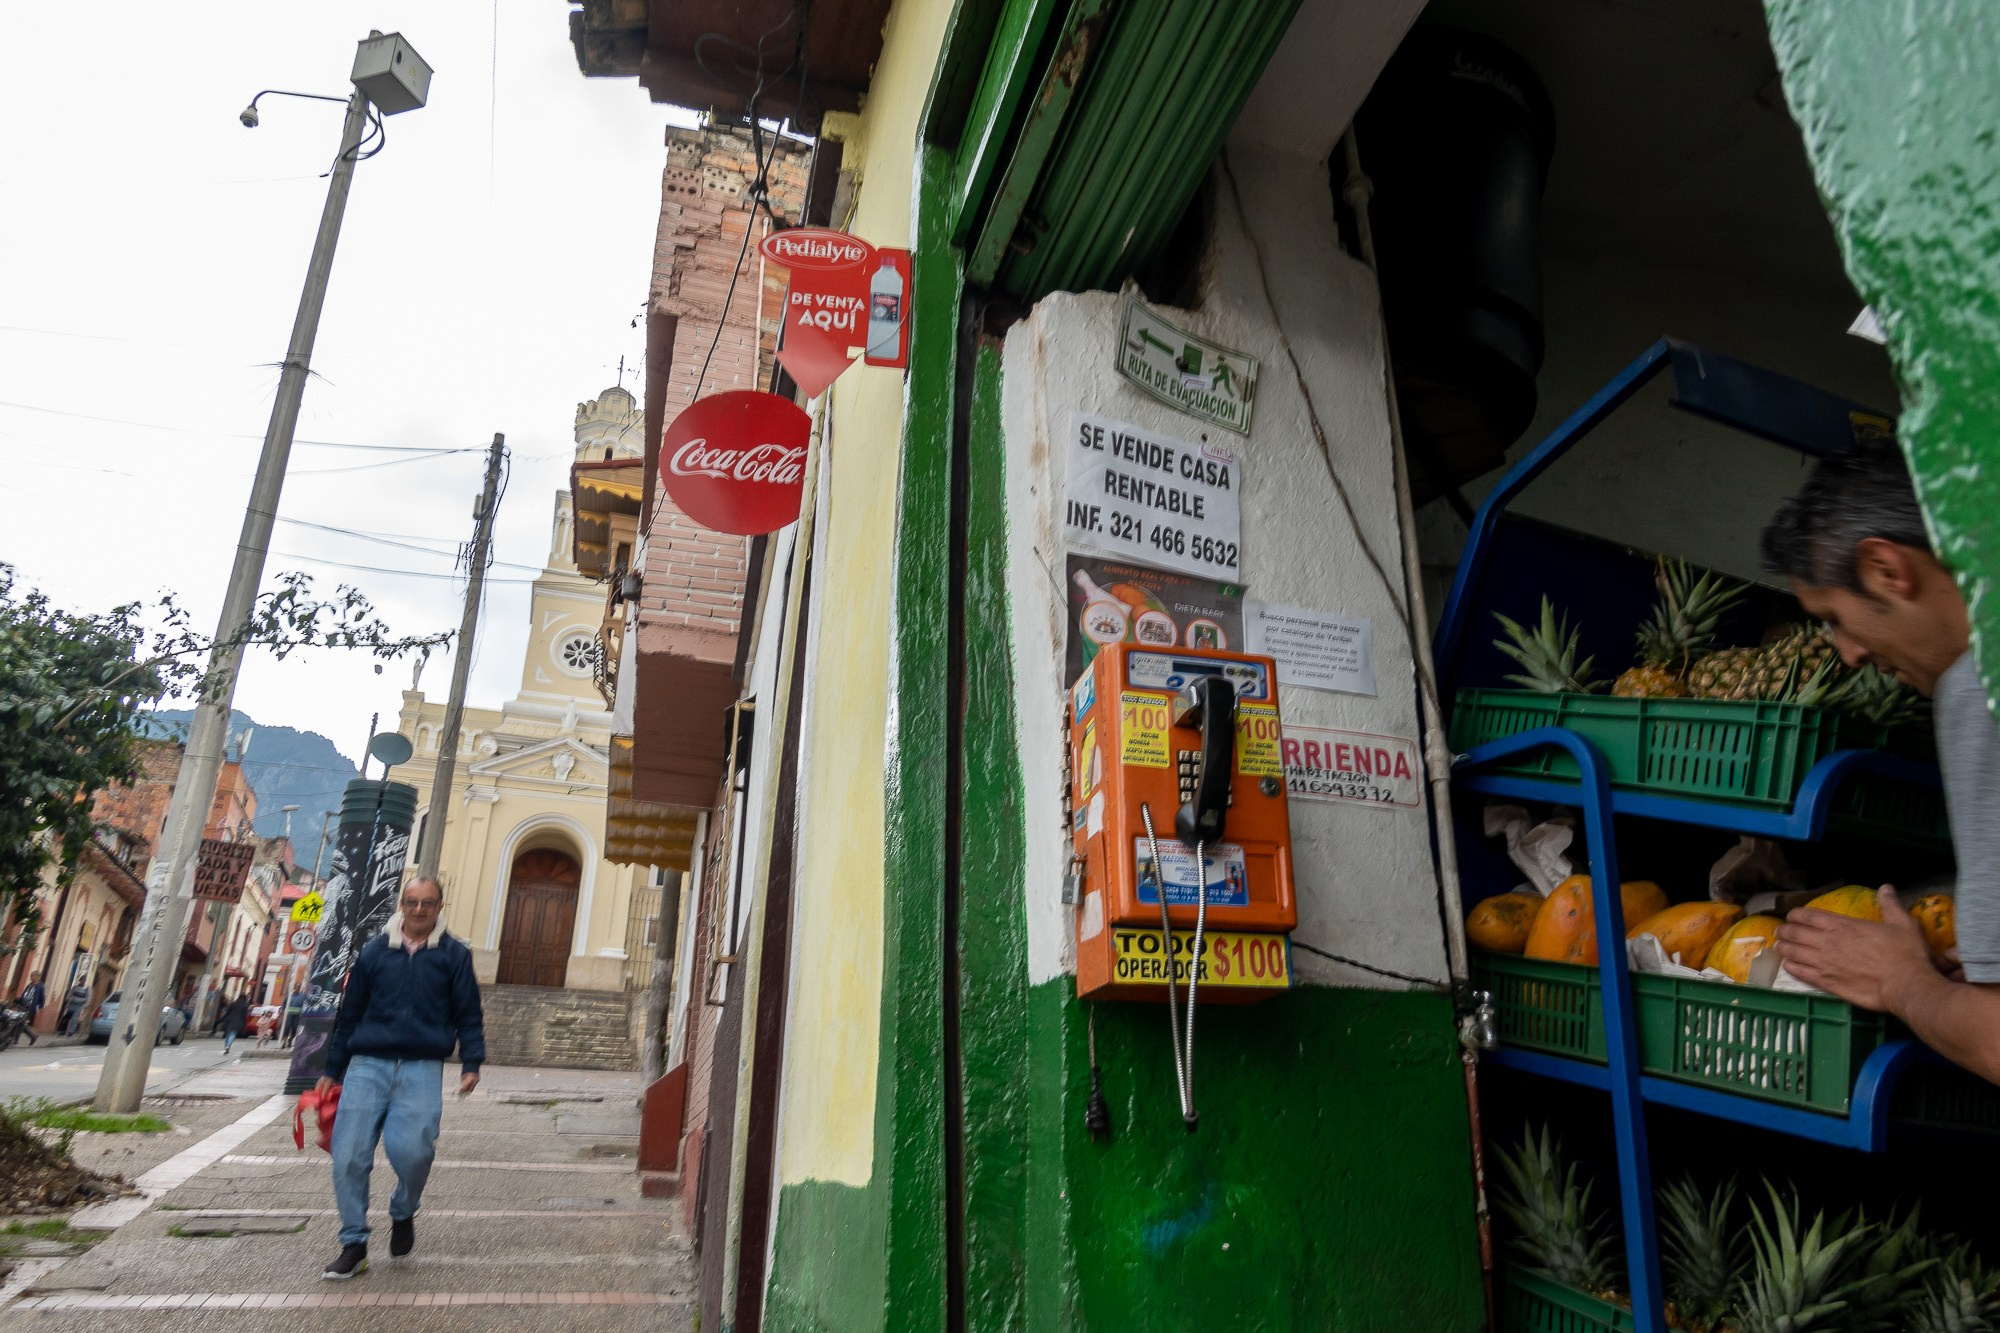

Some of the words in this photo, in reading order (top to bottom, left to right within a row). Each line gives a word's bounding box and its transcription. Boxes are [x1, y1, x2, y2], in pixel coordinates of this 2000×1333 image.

[775, 237, 864, 264] Pedialyte
[791, 292, 813, 307] DE
[815, 293, 866, 312] VENTA
[797, 309, 857, 333] AQUÍ
[1128, 353, 1153, 380] RUTA
[1154, 370, 1169, 392] DE
[1169, 379, 1237, 421] EVACUACION
[670, 437, 808, 485] Coca-Cola
[1079, 422, 1105, 451] SE
[1111, 430, 1175, 474] VENDE
[1180, 452, 1230, 491] CASA
[1104, 467, 1205, 520] RENTABLE
[1066, 498, 1103, 534] INF.
[1110, 510, 1142, 544] 321
[1150, 524, 1185, 556] 466
[1191, 533, 1238, 568] 5632
[1103, 564, 1139, 577] ALIMENTO
[1174, 602, 1199, 616] DIETA
[1202, 607, 1225, 619] BARF
[1259, 611, 1285, 623] Busco
[1285, 616, 1319, 629] personal
[1320, 622, 1338, 631] para
[1266, 626, 1279, 635] por
[220, 872, 239, 886] DE
[237, 862, 247, 873] Y
[294, 932, 313, 948] 30
[1116, 932, 1208, 955] TODO
[1117, 957, 1208, 980] OPERADOR
[1213, 936, 1284, 982] $100
